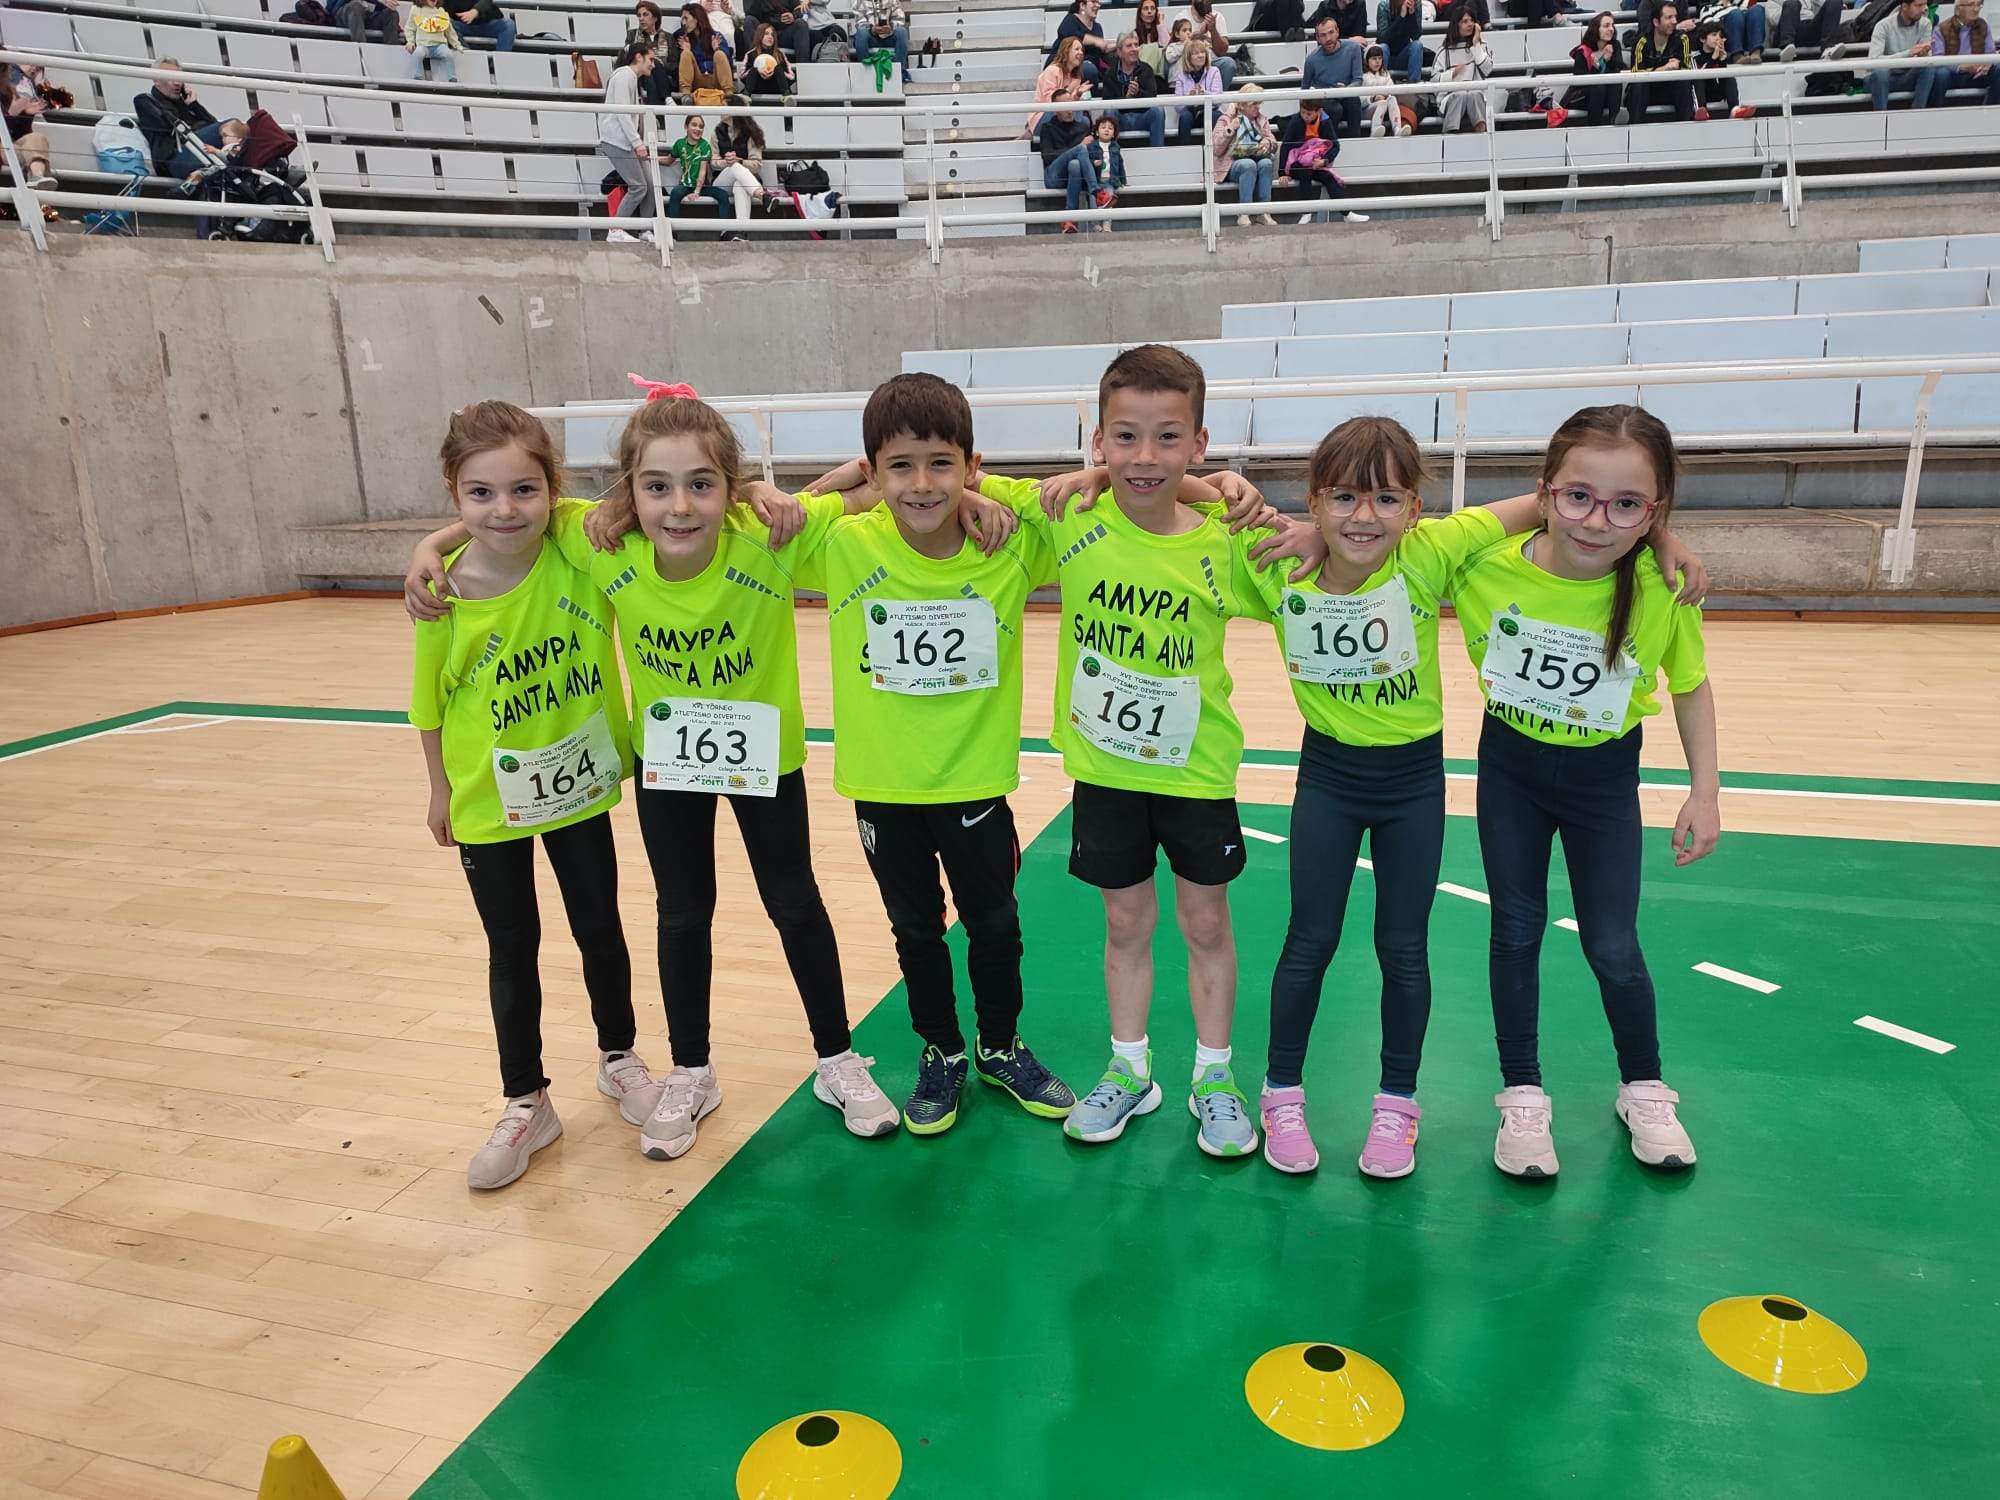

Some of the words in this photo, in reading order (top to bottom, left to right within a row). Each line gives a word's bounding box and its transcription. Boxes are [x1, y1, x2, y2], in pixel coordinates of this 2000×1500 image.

[1084, 256, 1099, 288] 4
[529, 297, 553, 328] 2
[359, 337, 383, 371] 1
[928, 612, 966, 620] DIVERTIDO
[1088, 580, 1189, 622] AMYPA
[1309, 606, 1346, 614] ATLETISMO
[1349, 600, 1385, 614] DIVERTIDO
[640, 621, 736, 652] AMYPA
[893, 629, 967, 667] 162
[1074, 614, 1144, 660] SANTA
[1156, 635, 1194, 670] ANA
[1311, 617, 1389, 657] 160
[1521, 631, 1564, 646] ATLETISMO
[1566, 642, 1607, 654] DIVERTID
[1543, 627, 1558, 636] XVI
[1560, 630, 1591, 642] TORNEO
[496, 630, 581, 685] AMYPA
[635, 643, 702, 688] SANTA
[712, 647, 753, 686] ANA
[1515, 648, 1601, 697] 159
[491, 680, 560, 731] SANTA
[566, 662, 603, 701] ANA
[1101, 672, 1139, 691] ATLETISMO
[1140, 686, 1178, 697] DIVERTIDO
[1120, 671, 1132, 679] XVI
[1135, 677, 1163, 688] TORNEO
[1322, 683, 1364, 704] NTA
[1376, 669, 1419, 706] ANA
[674, 710, 712, 719] ATLETISMO
[706, 703, 733, 711] TORNEO
[1097, 691, 1165, 737] 161
[676, 725, 747, 765] 163
[528, 749, 596, 800] 164
